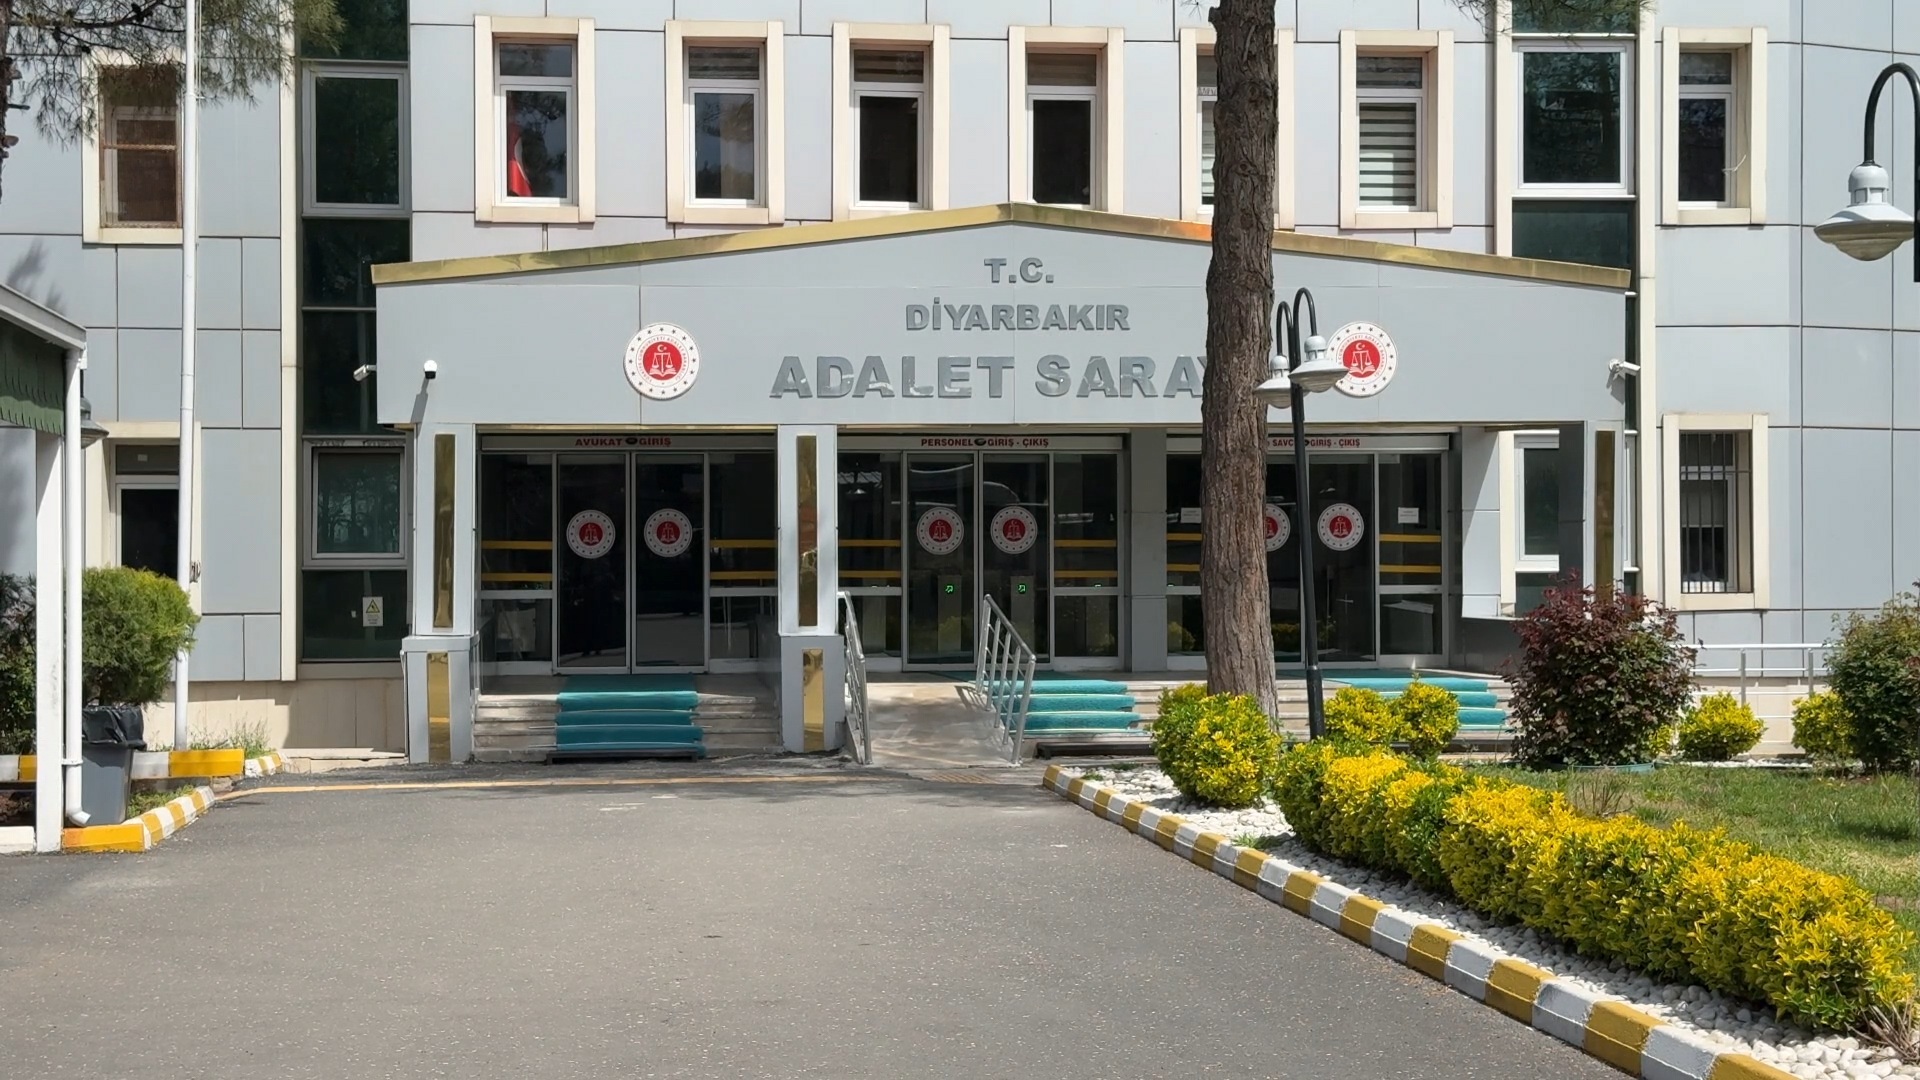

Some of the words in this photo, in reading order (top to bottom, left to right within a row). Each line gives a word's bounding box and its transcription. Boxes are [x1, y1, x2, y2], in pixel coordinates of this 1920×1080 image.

[984, 257, 1054, 283] T.C.
[906, 297, 1131, 331] DİYARBAKIR
[770, 355, 1015, 398] ADALET
[1035, 354, 1207, 398] SARA
[575, 437, 622, 446] AVUKAT
[639, 437, 671, 447] GİRİŞ
[921, 438, 974, 447] PERSONEL
[988, 437, 1014, 447] GİRİŞ
[1022, 438, 1049, 448] ÇIKIŞ
[1272, 439, 1294, 447] SAVC
[1310, 437, 1332, 448] GİRİŞ
[1339, 438, 1360, 448] ÇIKIŞ
